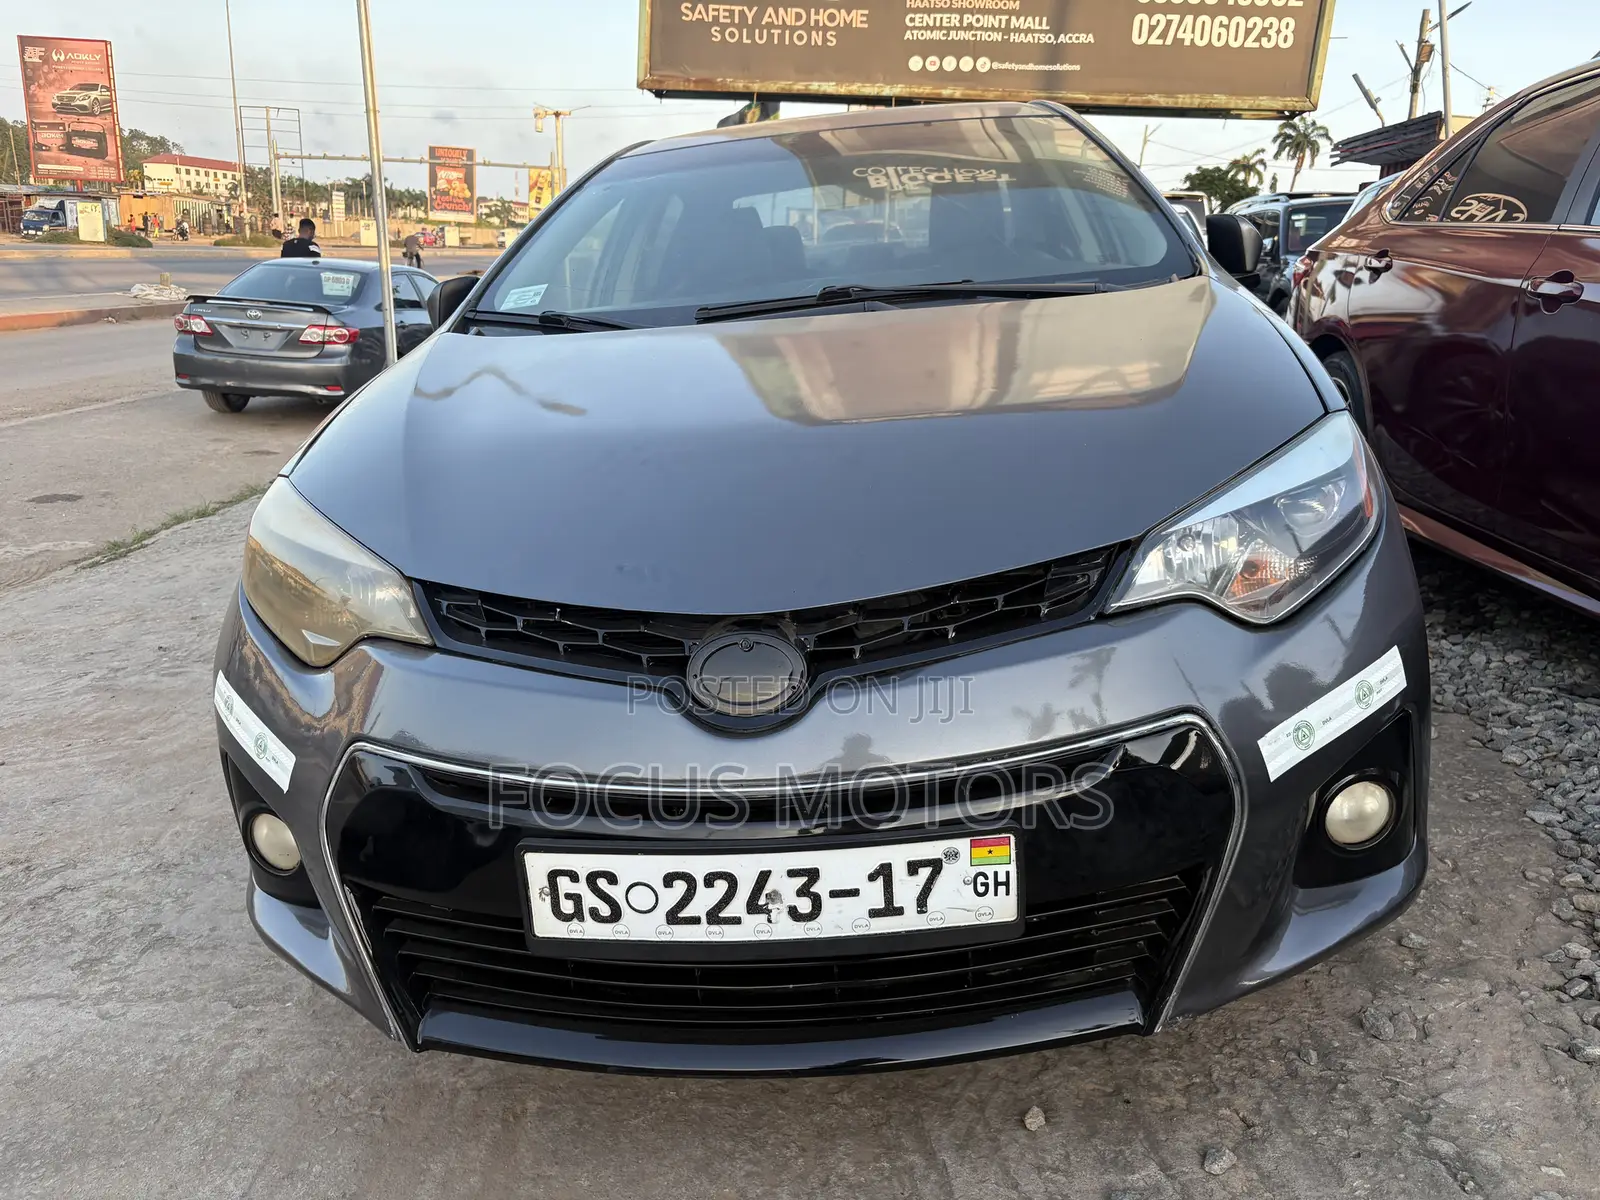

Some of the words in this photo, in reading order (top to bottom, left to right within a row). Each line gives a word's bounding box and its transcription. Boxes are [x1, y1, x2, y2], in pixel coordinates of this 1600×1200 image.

[906, 0, 950, 9] HAATSO
[951, 0, 1021, 11] SHOWROOM
[680, 2, 759, 25] SAFETY
[761, 6, 807, 26] AND
[810, 8, 870, 29] HOME
[905, 13, 960, 27] CENTER
[963, 15, 1009, 29] POINT
[1010, 16, 1050, 30] MALL
[710, 26, 838, 47] SOLUTIONS
[904, 30, 948, 41] ATOMIC
[948, 30, 1002, 42] JUNCTION
[1010, 33, 1057, 45] HAATSO,
[1057, 34, 1095, 44] ACCRA
[1131, 13, 1296, 49] 0274060238
[991, 61, 1081, 72] @safetyandhomesolutions
[546, 868, 622, 925] GS
[662, 857, 945, 926] 2243-17
[972, 870, 1012, 898] GH
